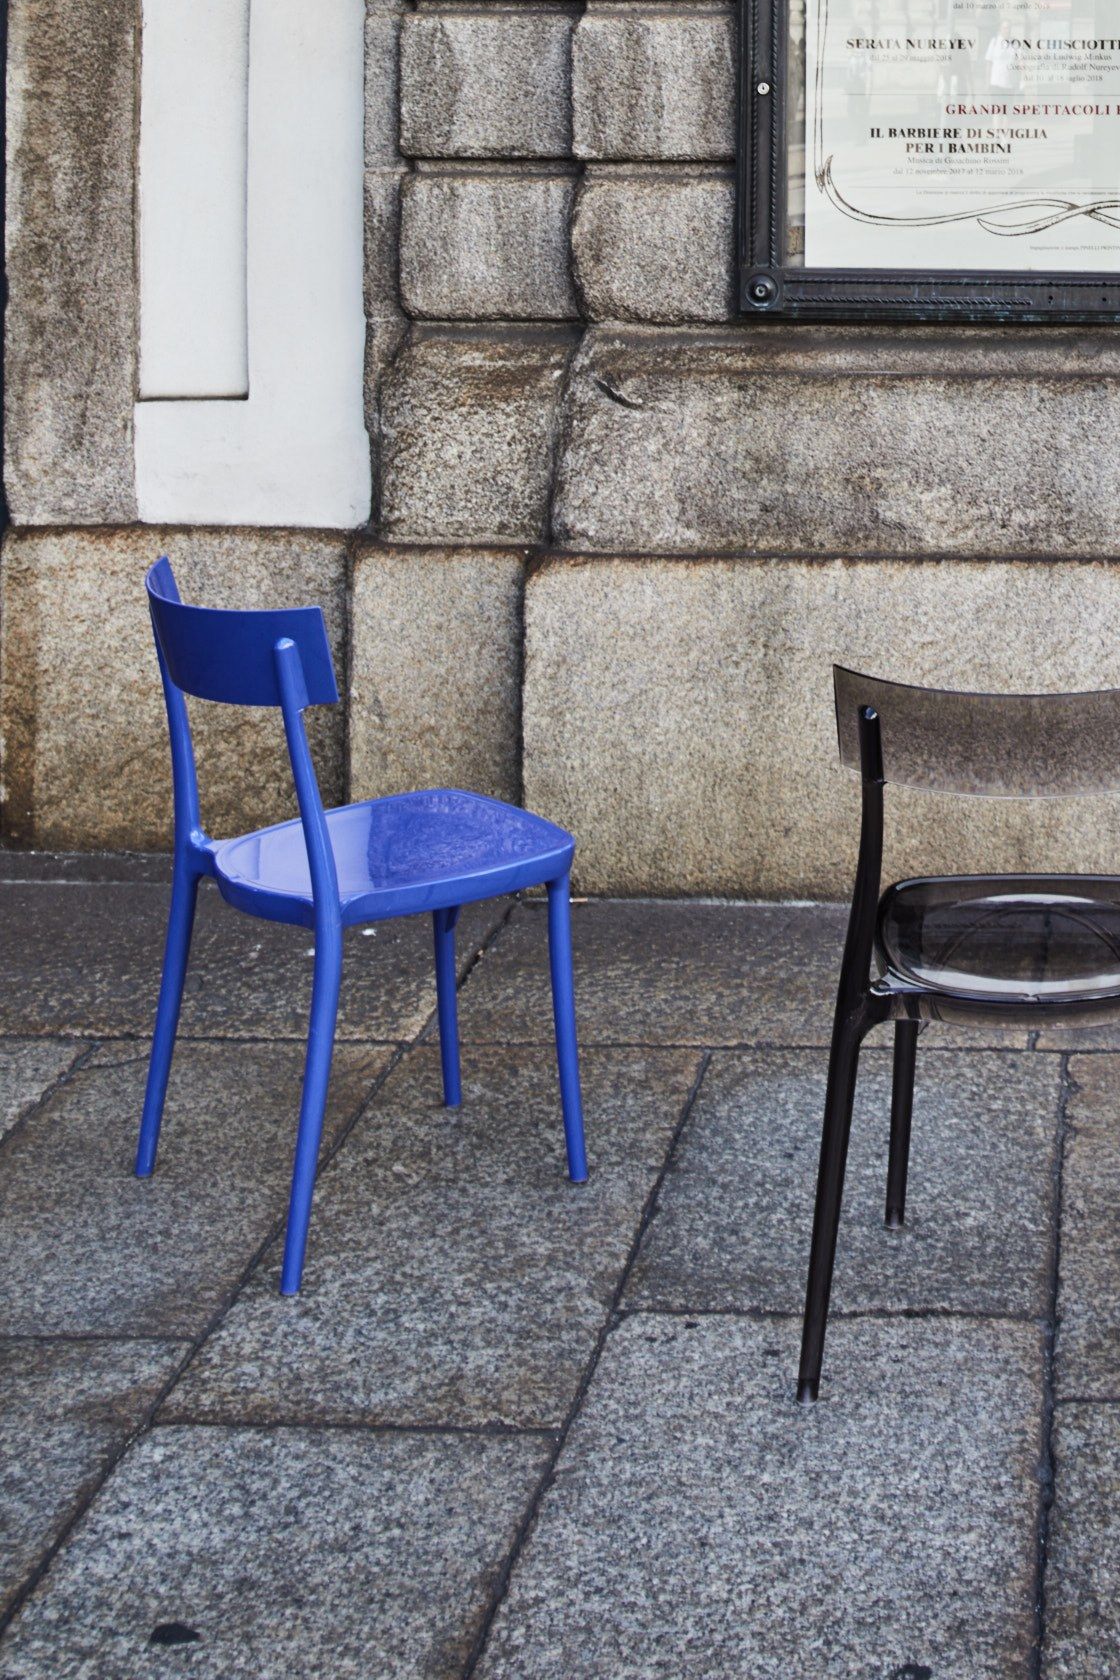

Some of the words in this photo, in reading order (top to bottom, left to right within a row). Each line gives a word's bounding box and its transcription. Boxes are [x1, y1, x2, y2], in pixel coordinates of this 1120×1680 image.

[846, 39, 901, 50] SERATA
[905, 39, 977, 50] NUREYEV
[945, 104, 1007, 115] GRANDI
[1012, 104, 1110, 115] SPETTACOLI
[870, 128, 884, 139] IL
[888, 128, 962, 139] BARBIERE
[967, 128, 981, 139] DI
[986, 128, 1048, 139] SIVIGLIA
[906, 143, 935, 154] PER
[939, 143, 944, 154] I
[948, 143, 1011, 154] BAMBINI
